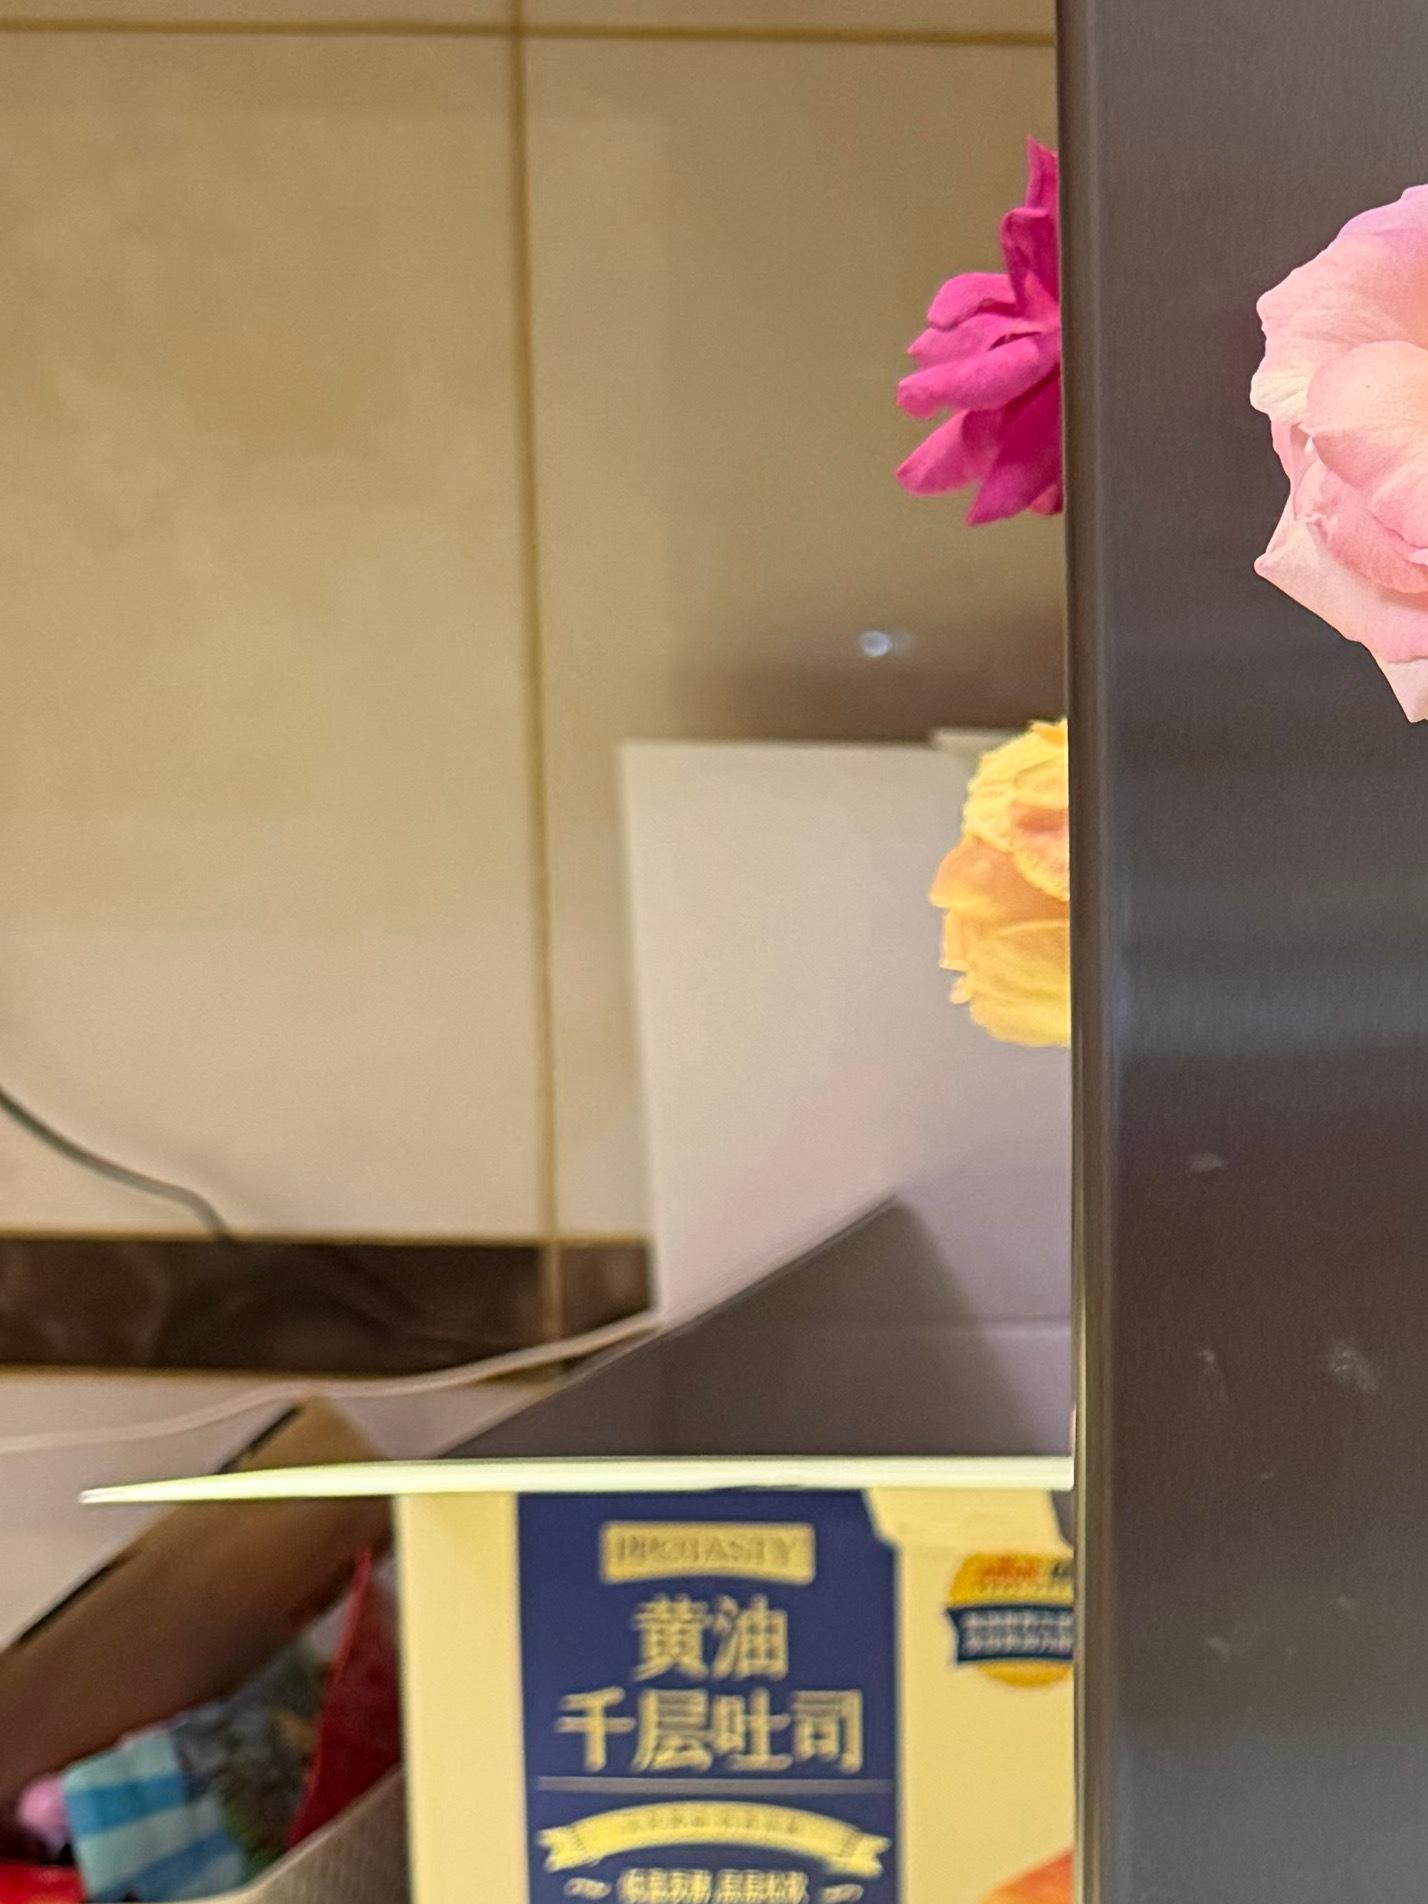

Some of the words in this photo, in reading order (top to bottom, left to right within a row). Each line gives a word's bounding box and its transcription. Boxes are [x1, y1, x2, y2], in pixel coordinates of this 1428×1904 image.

[632, 1594, 791, 1681] 黄油
[554, 1686, 865, 1775] 千层吐司
